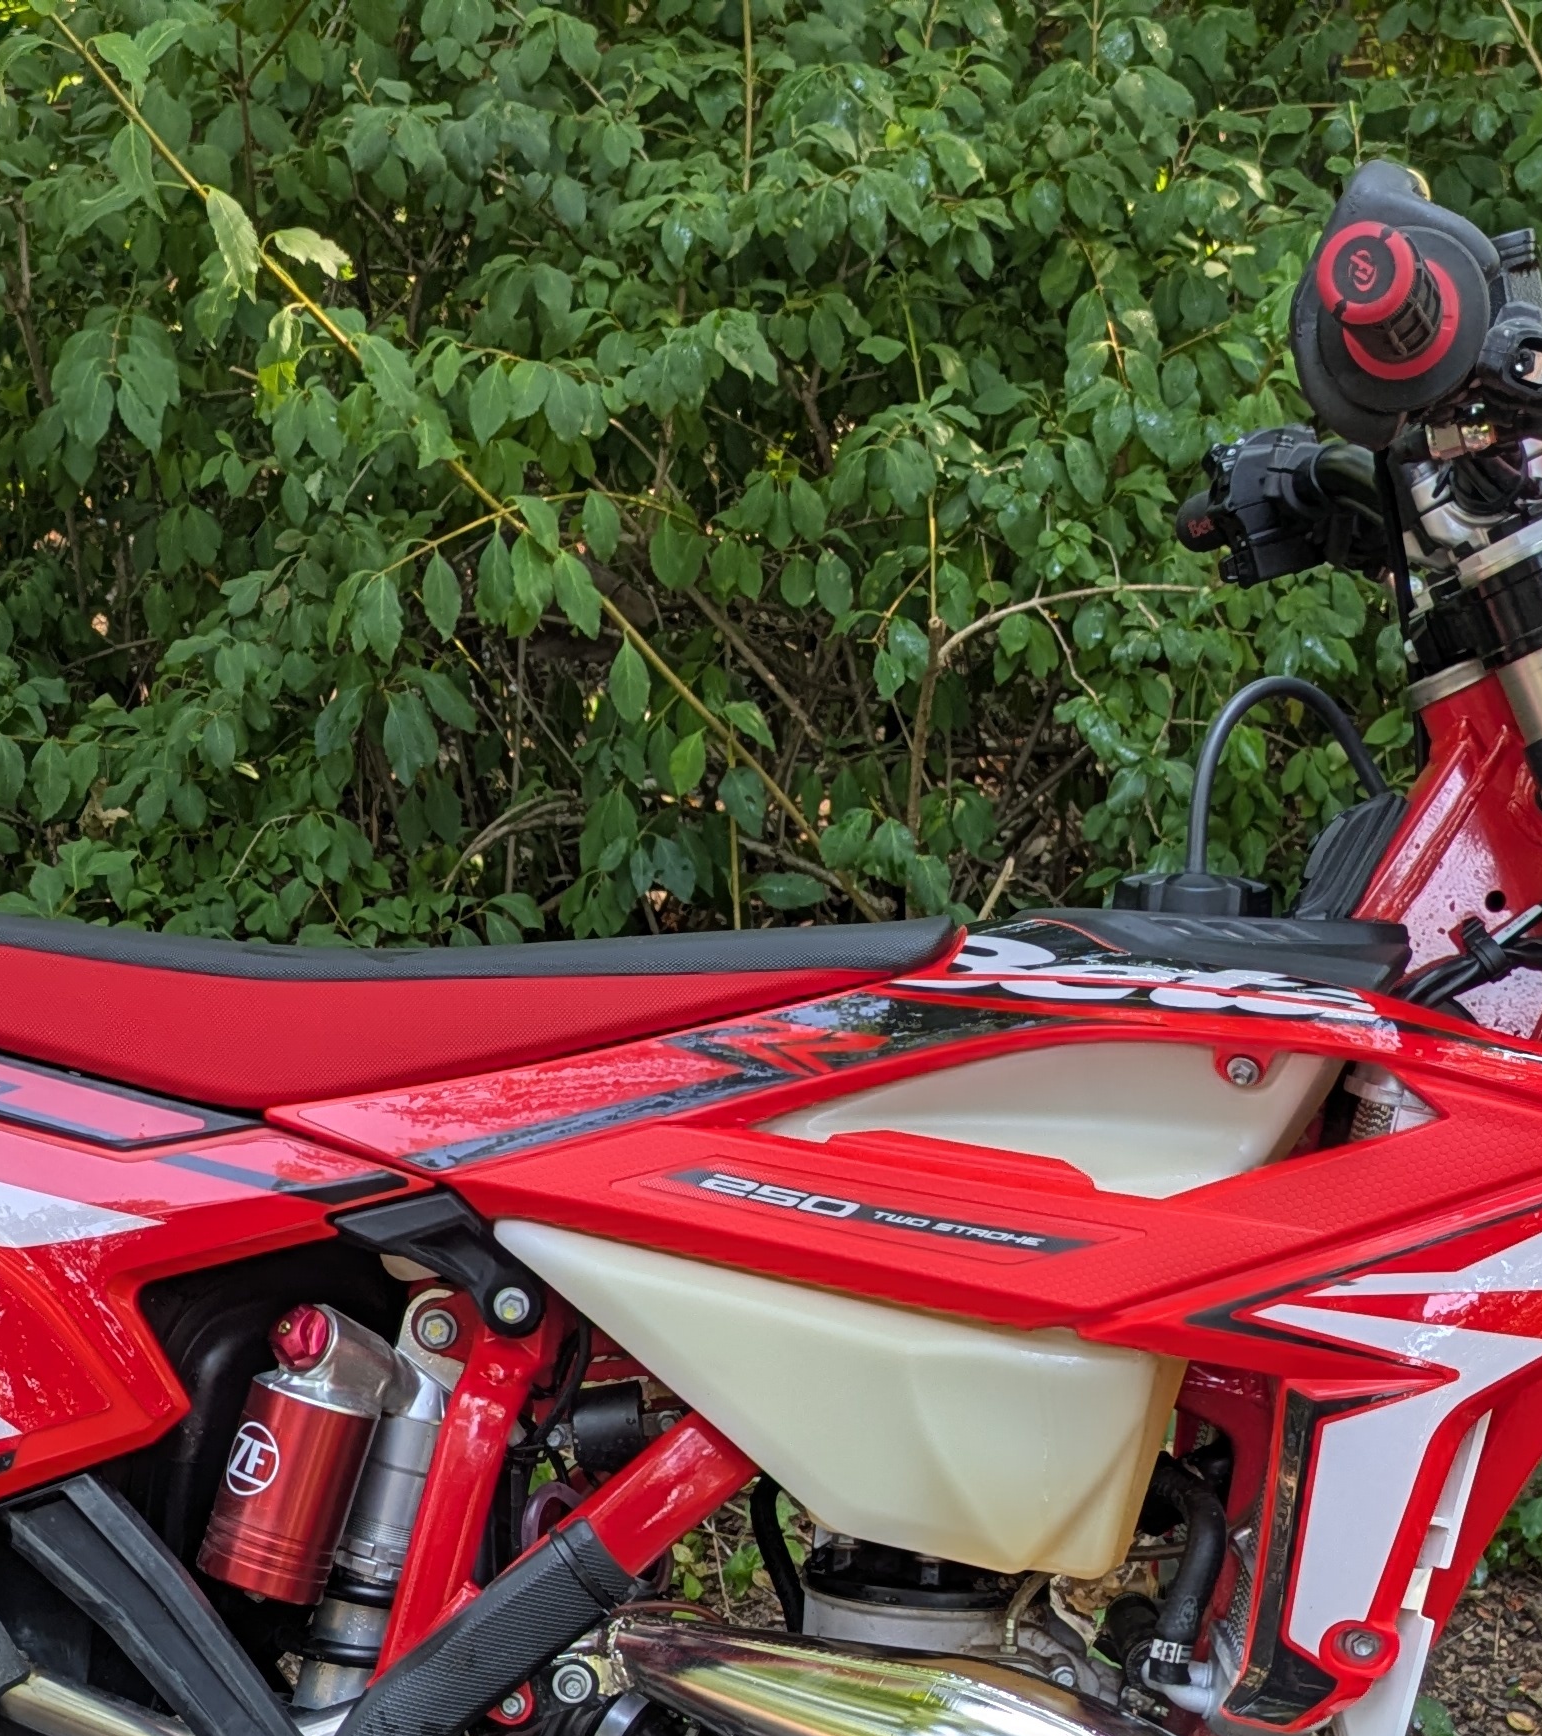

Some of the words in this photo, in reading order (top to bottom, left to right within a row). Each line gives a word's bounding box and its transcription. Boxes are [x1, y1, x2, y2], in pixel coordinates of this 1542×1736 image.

[698, 1173, 861, 1218] 250
[873, 1210, 931, 1228] TWO
[932, 1222, 1047, 1248] STROKE
[228, 1426, 277, 1490] ZF
